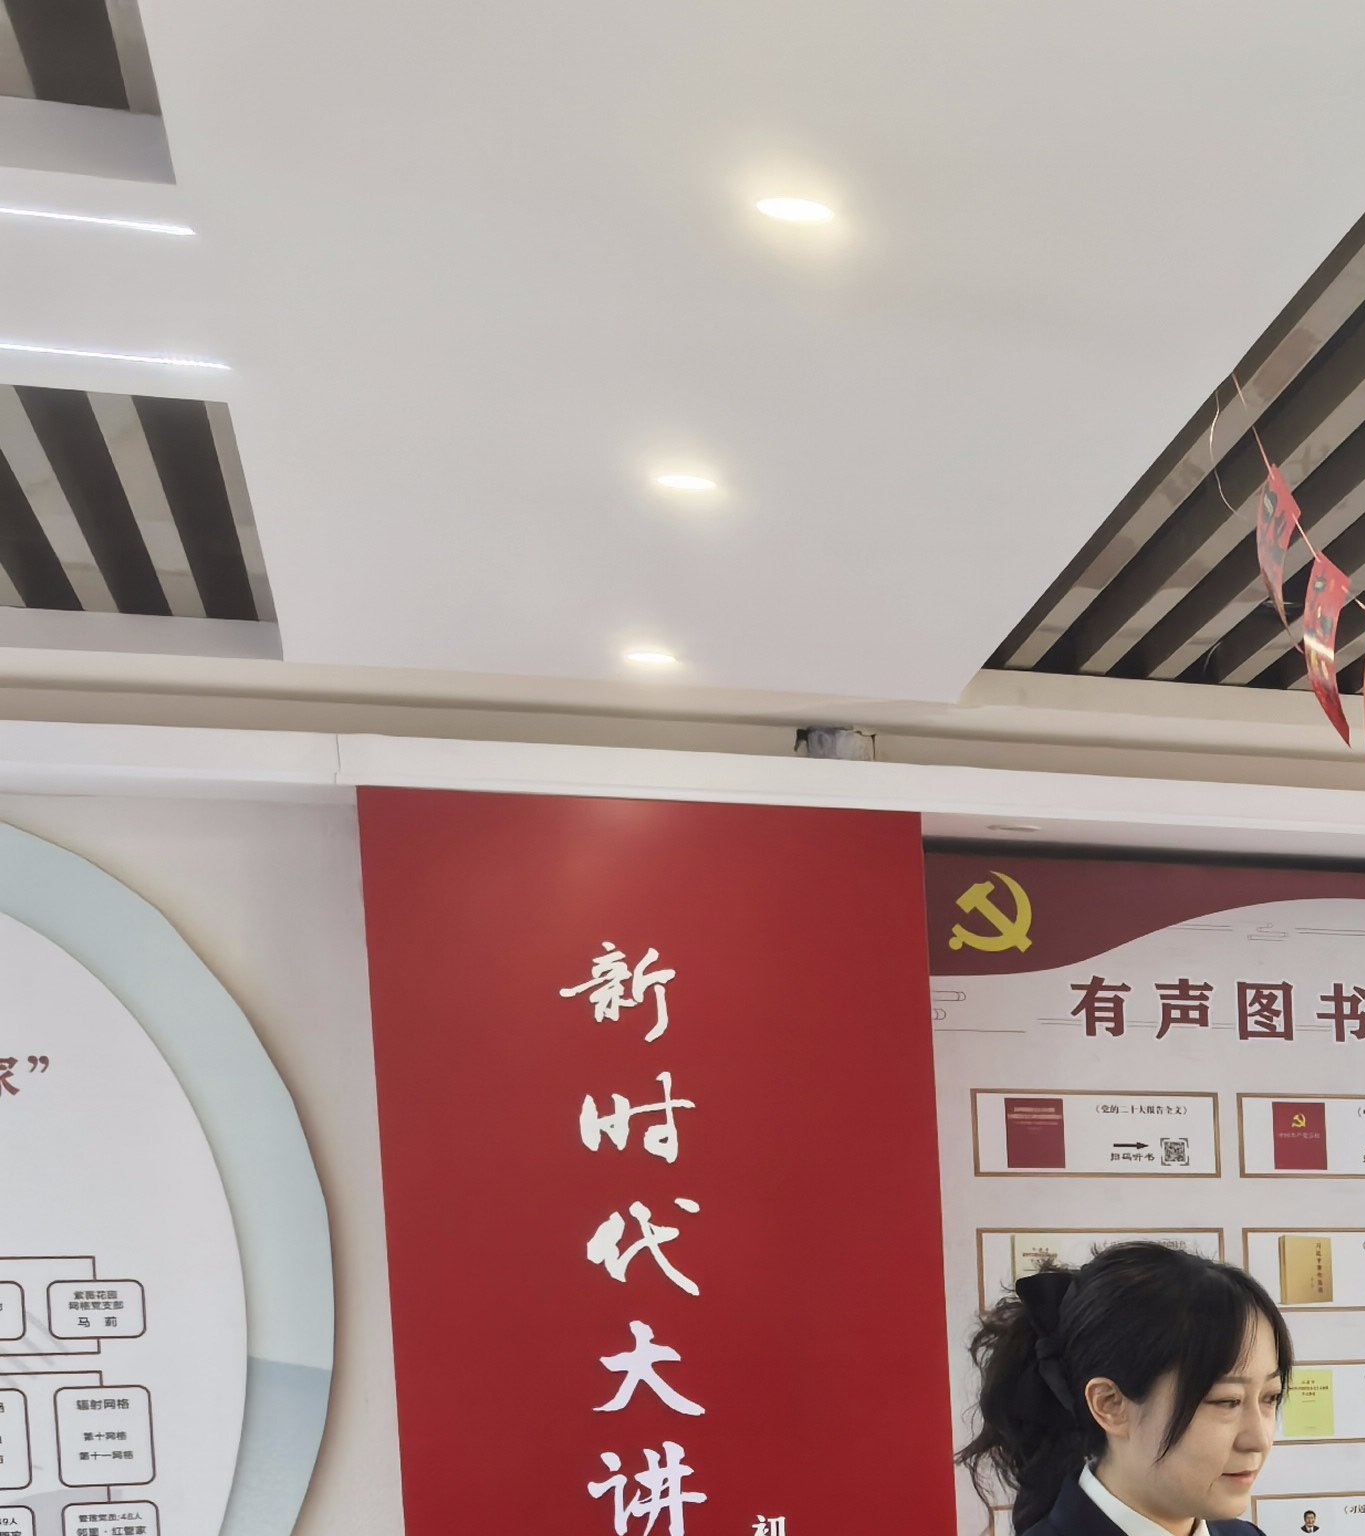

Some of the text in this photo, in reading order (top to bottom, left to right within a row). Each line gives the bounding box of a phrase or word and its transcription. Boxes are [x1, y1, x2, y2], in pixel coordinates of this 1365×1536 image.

[1110, 1152, 1155, 1163] 扫码听书
[83, 1431, 127, 1441] 第十网格
[79, 1450, 134, 1461] 第十一网格
